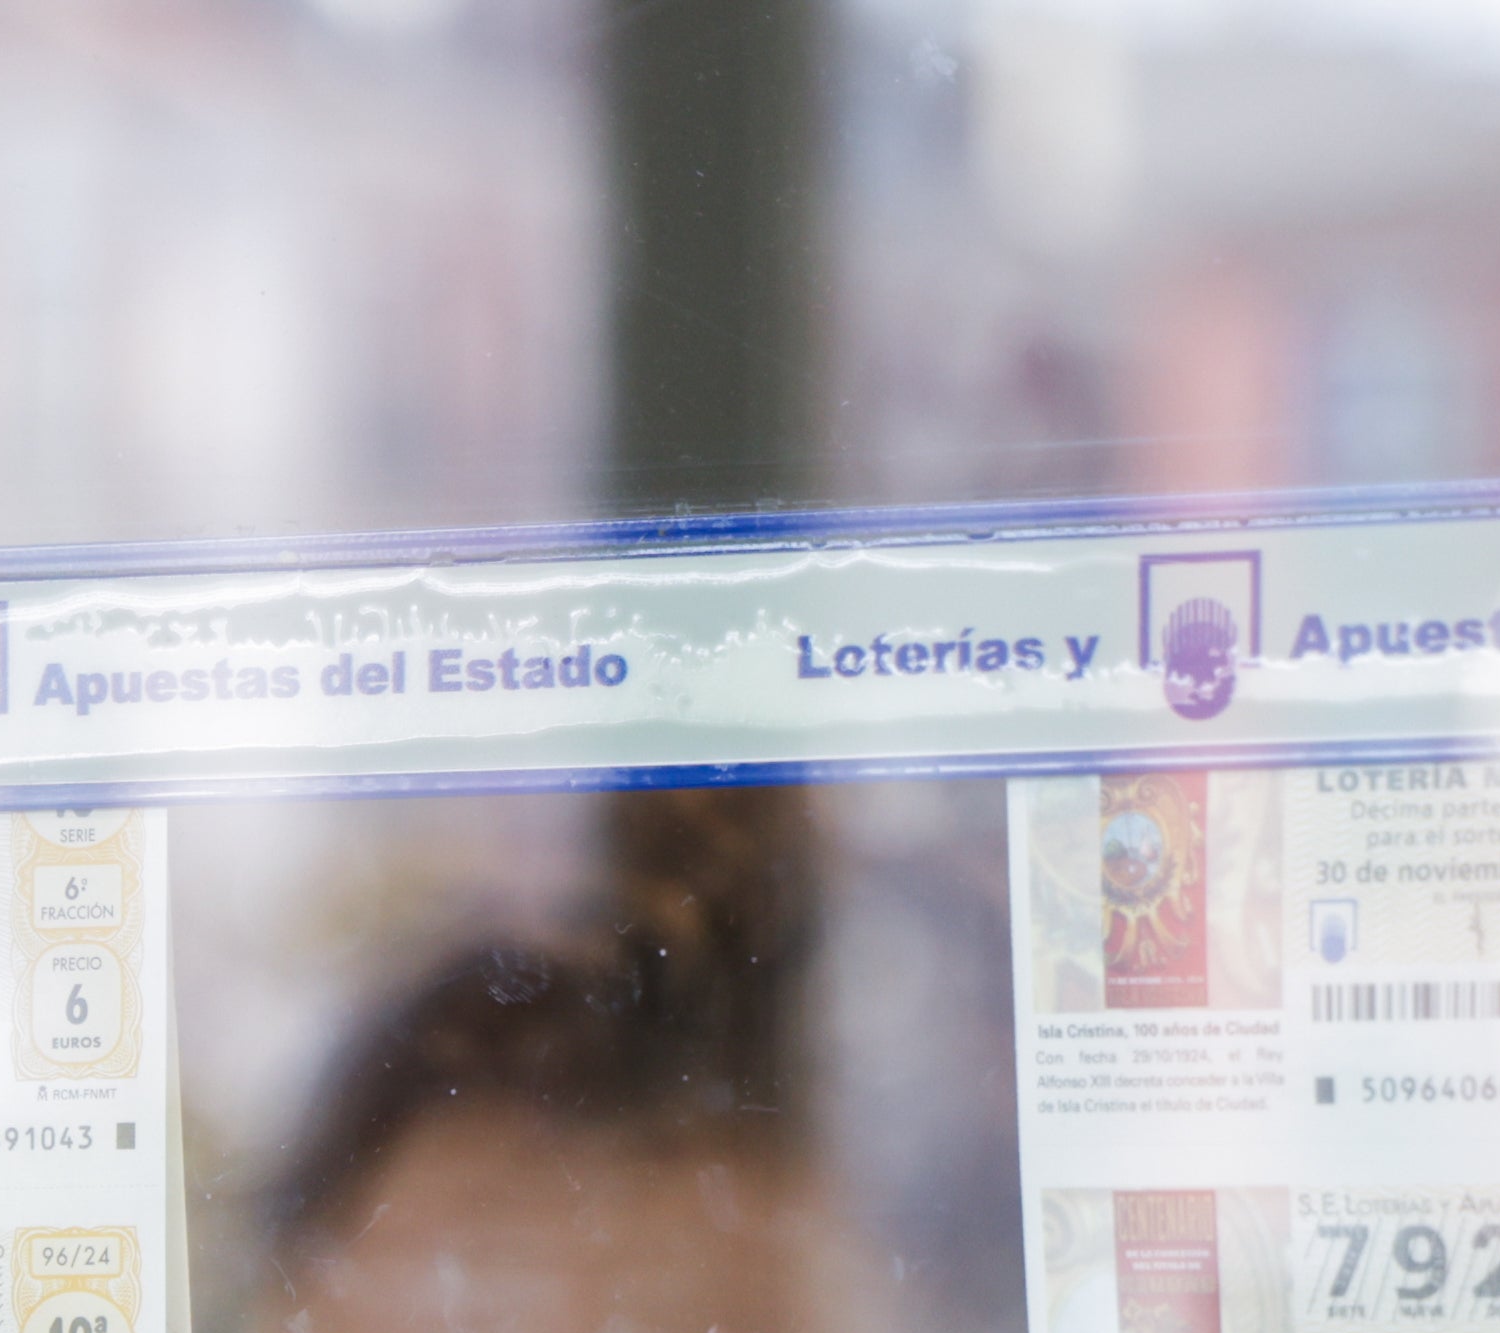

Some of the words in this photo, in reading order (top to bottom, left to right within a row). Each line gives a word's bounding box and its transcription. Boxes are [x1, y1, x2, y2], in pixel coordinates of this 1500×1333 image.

[34, 660, 301, 712] Apuestas
[320, 650, 405, 696] del
[429, 645, 629, 692] Estado
[796, 628, 1045, 679] Loterías
[1063, 633, 1100, 681] y
